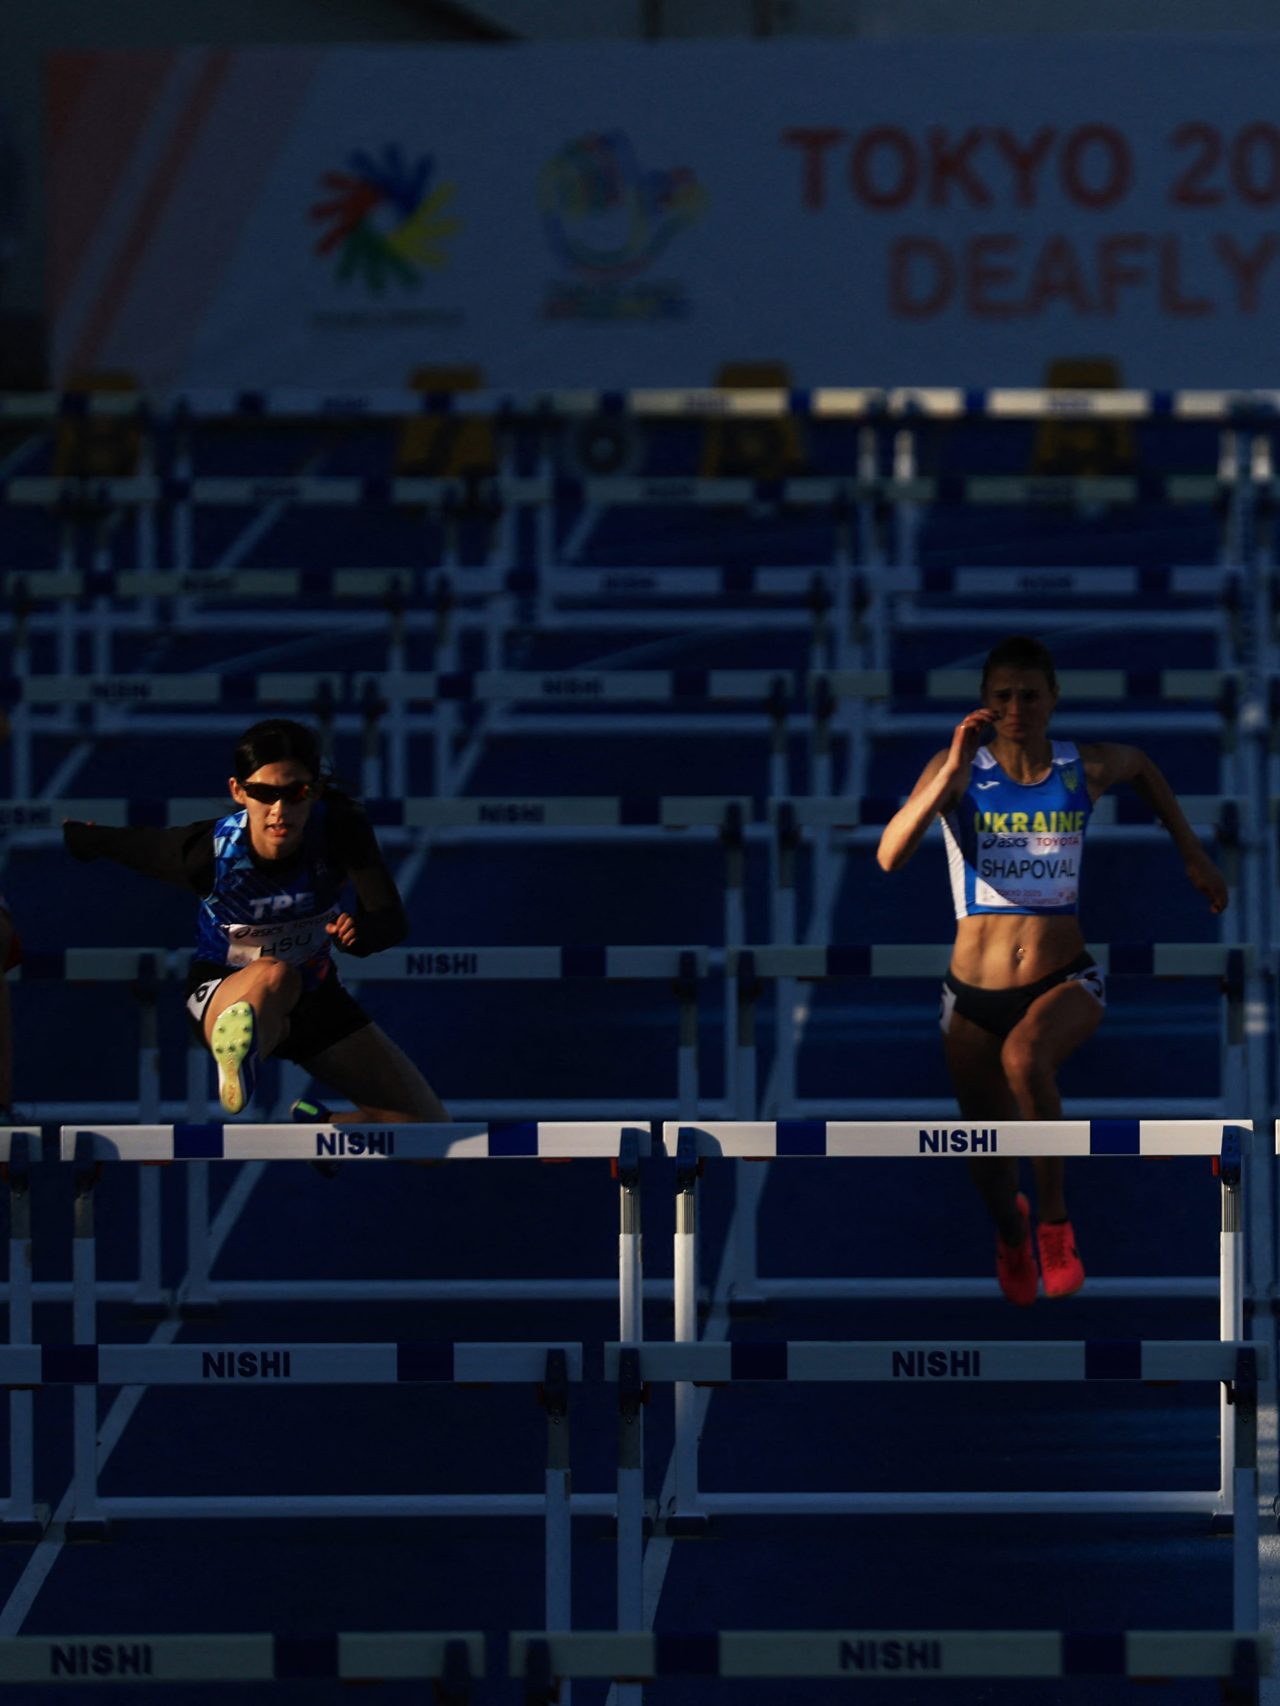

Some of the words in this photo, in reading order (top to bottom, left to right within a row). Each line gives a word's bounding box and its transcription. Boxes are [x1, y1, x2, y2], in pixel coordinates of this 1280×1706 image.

[784, 124, 1133, 211] TOKYO
[479, 803, 545, 823] NISHI
[974, 811, 1086, 833] UKRAINE
[1035, 836, 1080, 847] TOYOTA
[981, 859, 1077, 879] SHAPOVAL
[249, 891, 316, 921] TPE
[261, 932, 312, 957] HSU
[406, 954, 478, 975] NISHI
[316, 1131, 395, 1157] NISHI
[918, 1130, 998, 1154] NISHI
[202, 1351, 291, 1378] NISHI
[892, 1350, 980, 1377] NISHI
[51, 1645, 153, 1676] NISHI
[839, 1640, 942, 1671] NISHI
